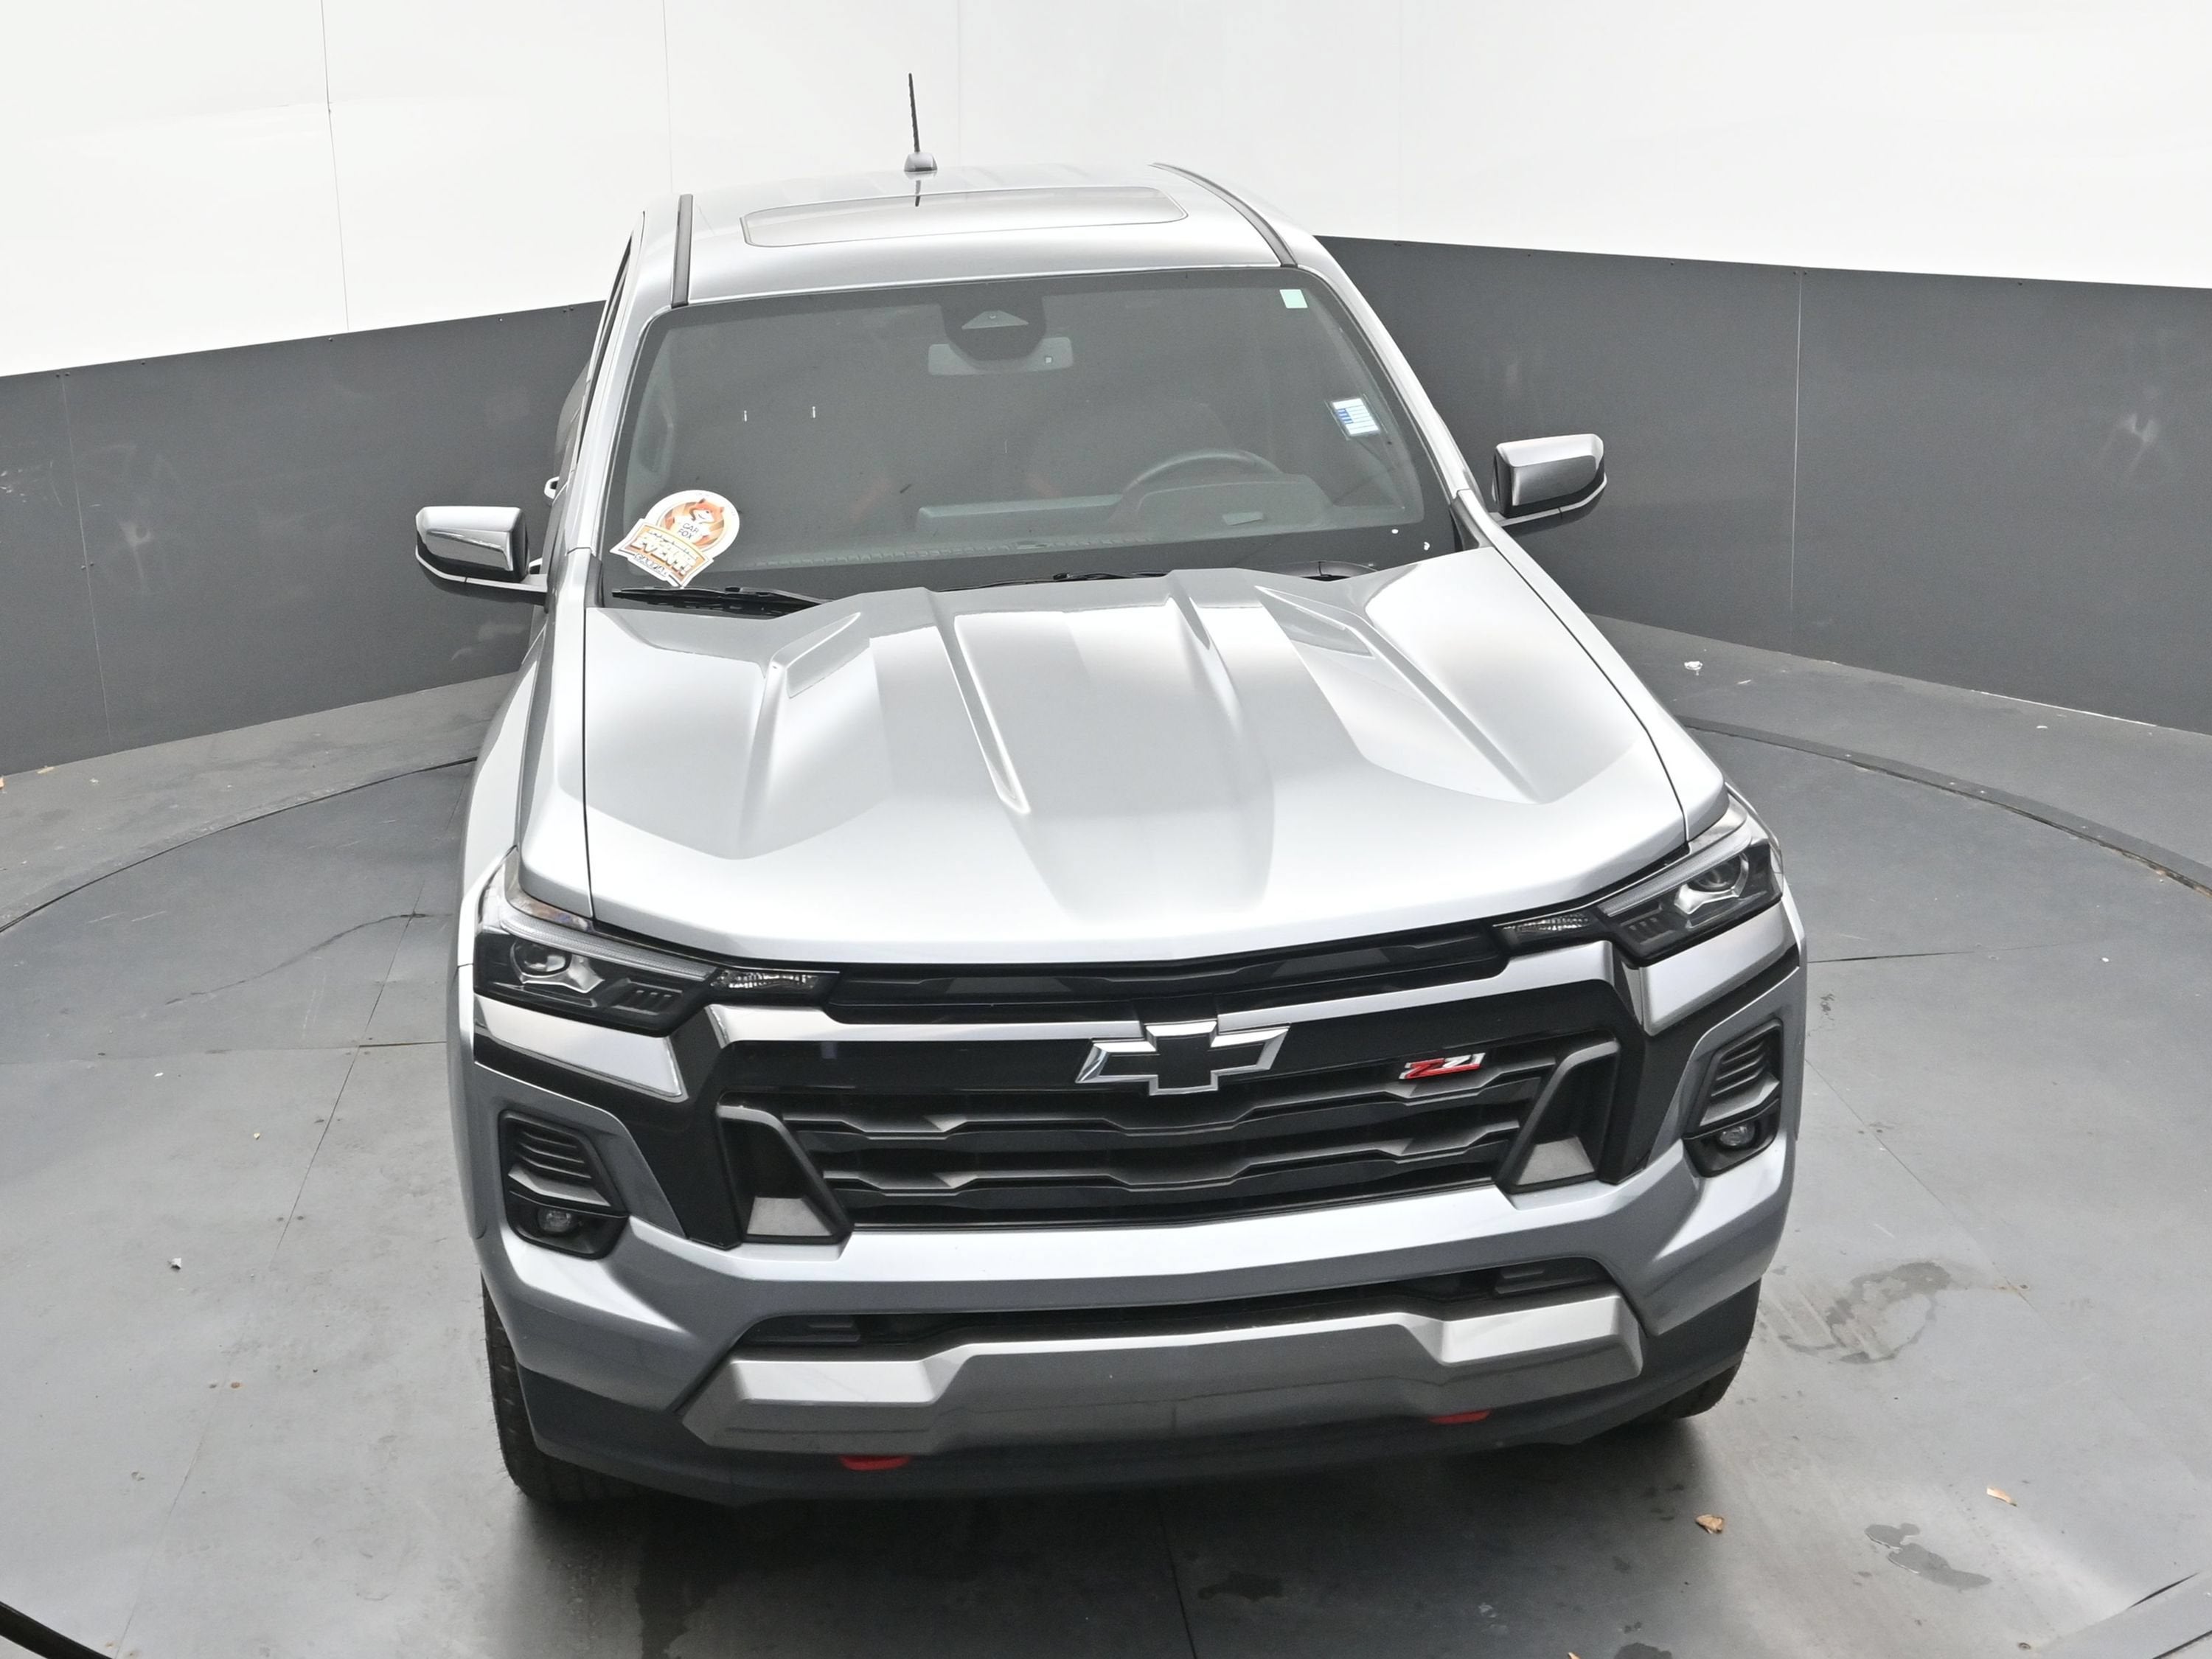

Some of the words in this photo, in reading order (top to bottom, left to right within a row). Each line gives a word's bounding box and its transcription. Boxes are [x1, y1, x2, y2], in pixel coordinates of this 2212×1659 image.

[682, 522, 699, 534] CAR
[678, 529, 695, 540] FOX
[1399, 1052, 1485, 1079] Z71
